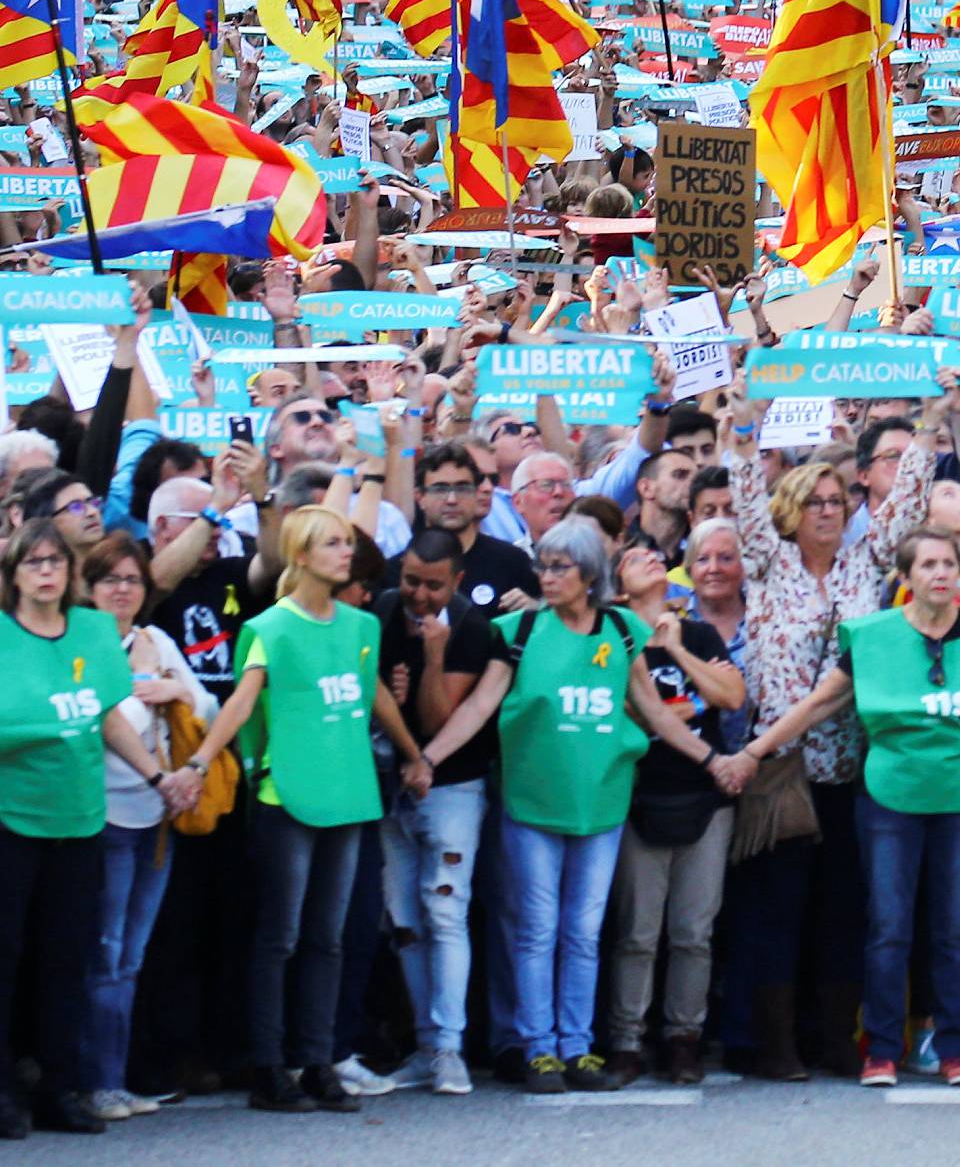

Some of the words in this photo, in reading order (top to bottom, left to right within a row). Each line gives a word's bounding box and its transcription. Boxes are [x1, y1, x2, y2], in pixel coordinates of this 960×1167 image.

[634, 27, 706, 49] LLIBRTAT
[670, 165, 745, 197] PRESOS
[3, 290, 126, 311] CATALONIA
[349, 303, 456, 318] CATALONIA
[492, 349, 635, 376] LLIBERTAT
[752, 363, 805, 384] HELP
[811, 363, 932, 384] CATALONIA
[316, 672, 362, 706] 11S
[558, 685, 614, 717] 11S
[49, 688, 102, 721] 11S
